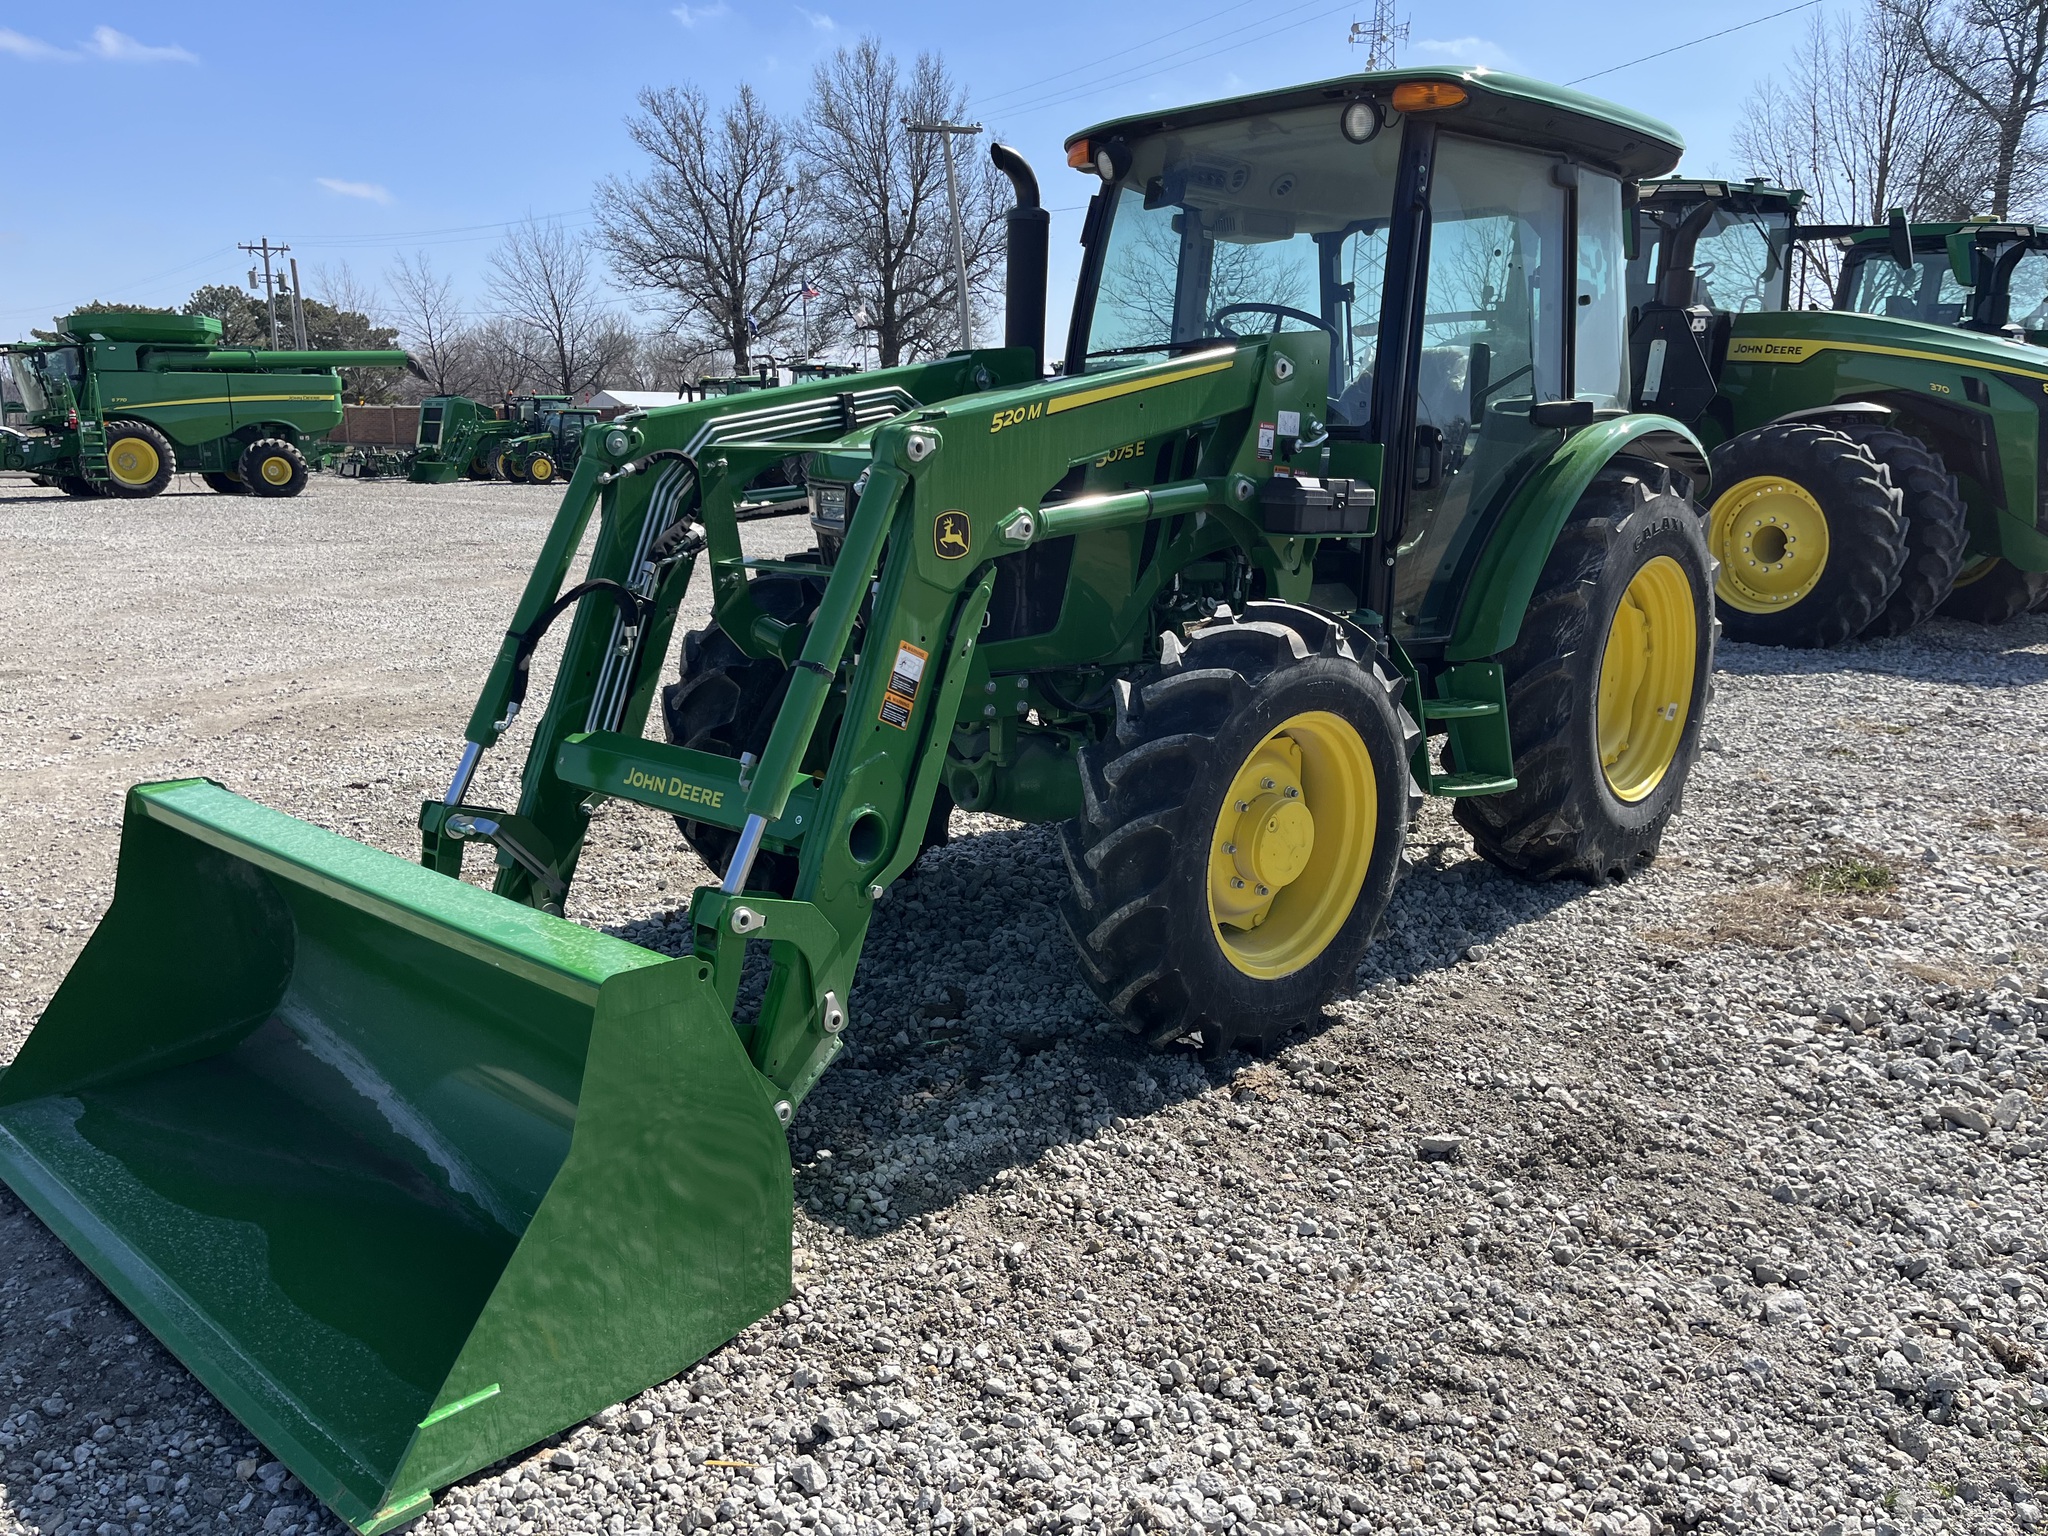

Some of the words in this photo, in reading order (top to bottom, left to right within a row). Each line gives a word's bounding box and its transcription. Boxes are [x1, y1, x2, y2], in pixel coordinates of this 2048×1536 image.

[1734, 343, 1763, 354] JOHN
[1765, 344, 1803, 355] DEERE
[1929, 382, 1950, 394] 370
[990, 406, 1026, 433] 520
[1027, 402, 1042, 421] M
[1135, 440, 1145, 457] E
[1633, 516, 1685, 553] GALAXY
[623, 767, 667, 794] JOHN
[667, 777, 724, 808] DEERE
